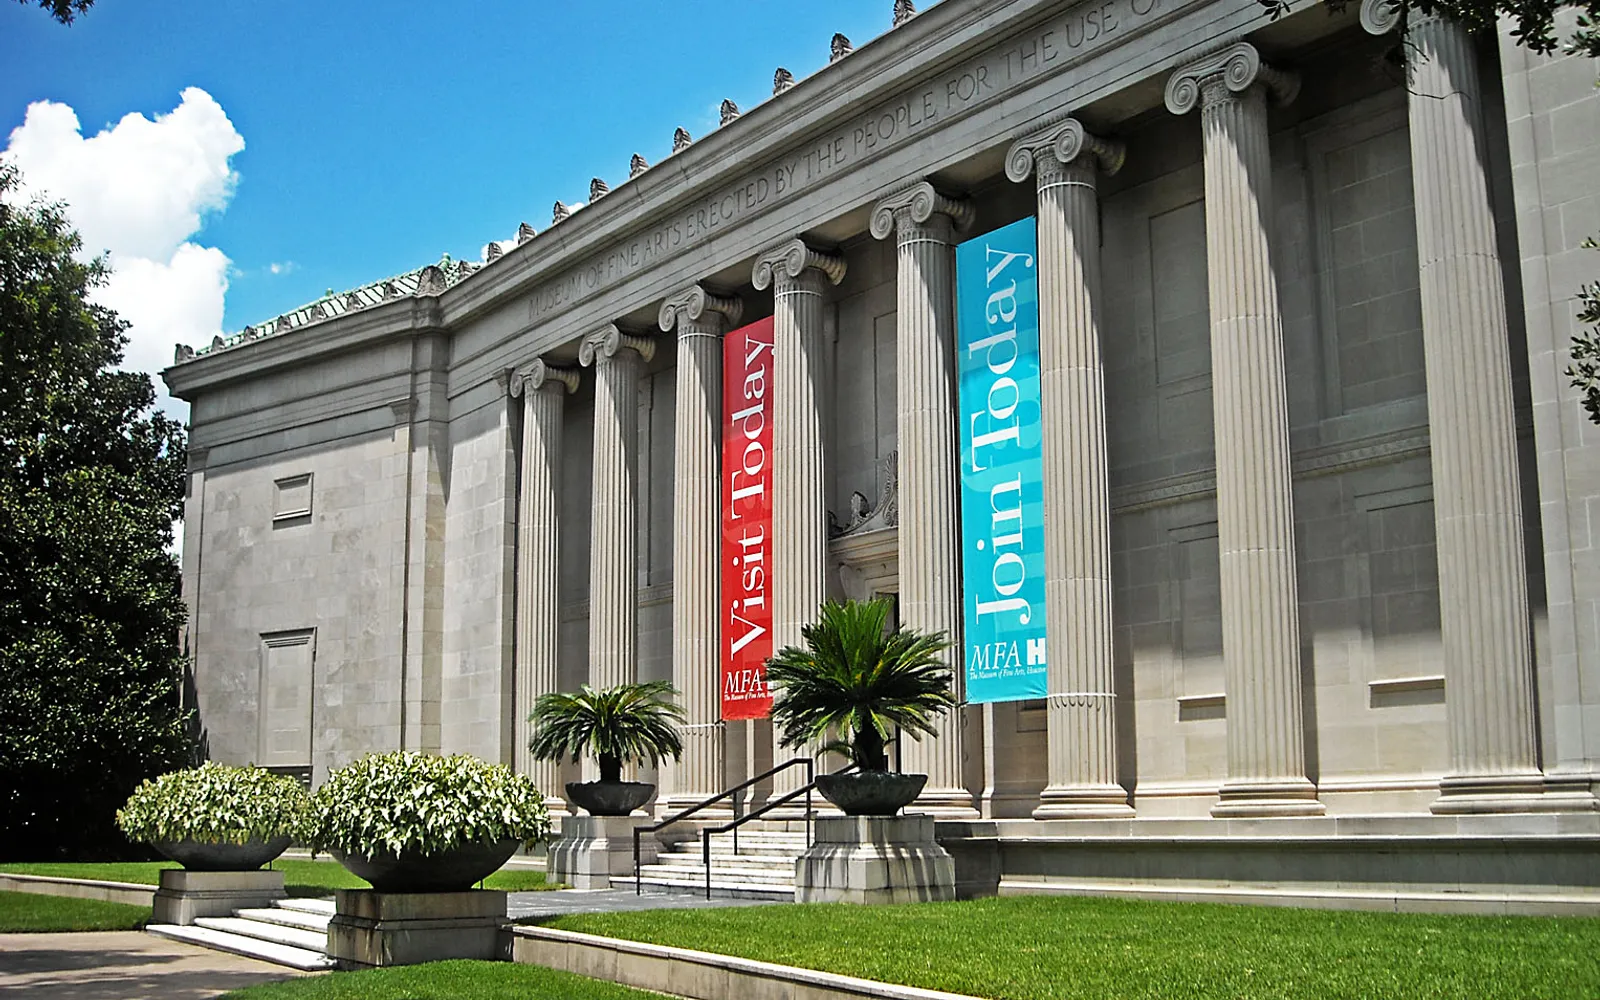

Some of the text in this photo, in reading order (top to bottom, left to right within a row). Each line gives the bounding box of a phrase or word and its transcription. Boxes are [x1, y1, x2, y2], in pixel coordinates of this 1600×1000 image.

[528, 272, 585, 320] MUSEUM
[586, 261, 604, 289] OF
[607, 243, 640, 278] FINE
[643, 219, 682, 264] ARTS
[685, 177, 770, 238] ERECTED
[775, 161, 797, 194] BY
[802, 136, 847, 180] THE
[852, 90, 938, 155] PEOPLE
[945, 65, 993, 110] FOR
[1000, 29, 1059, 81] THE
[1065, 1, 1119, 49] USE
[731, 333, 775, 662] Visit Today
[967, 242, 1035, 626] Join Today
